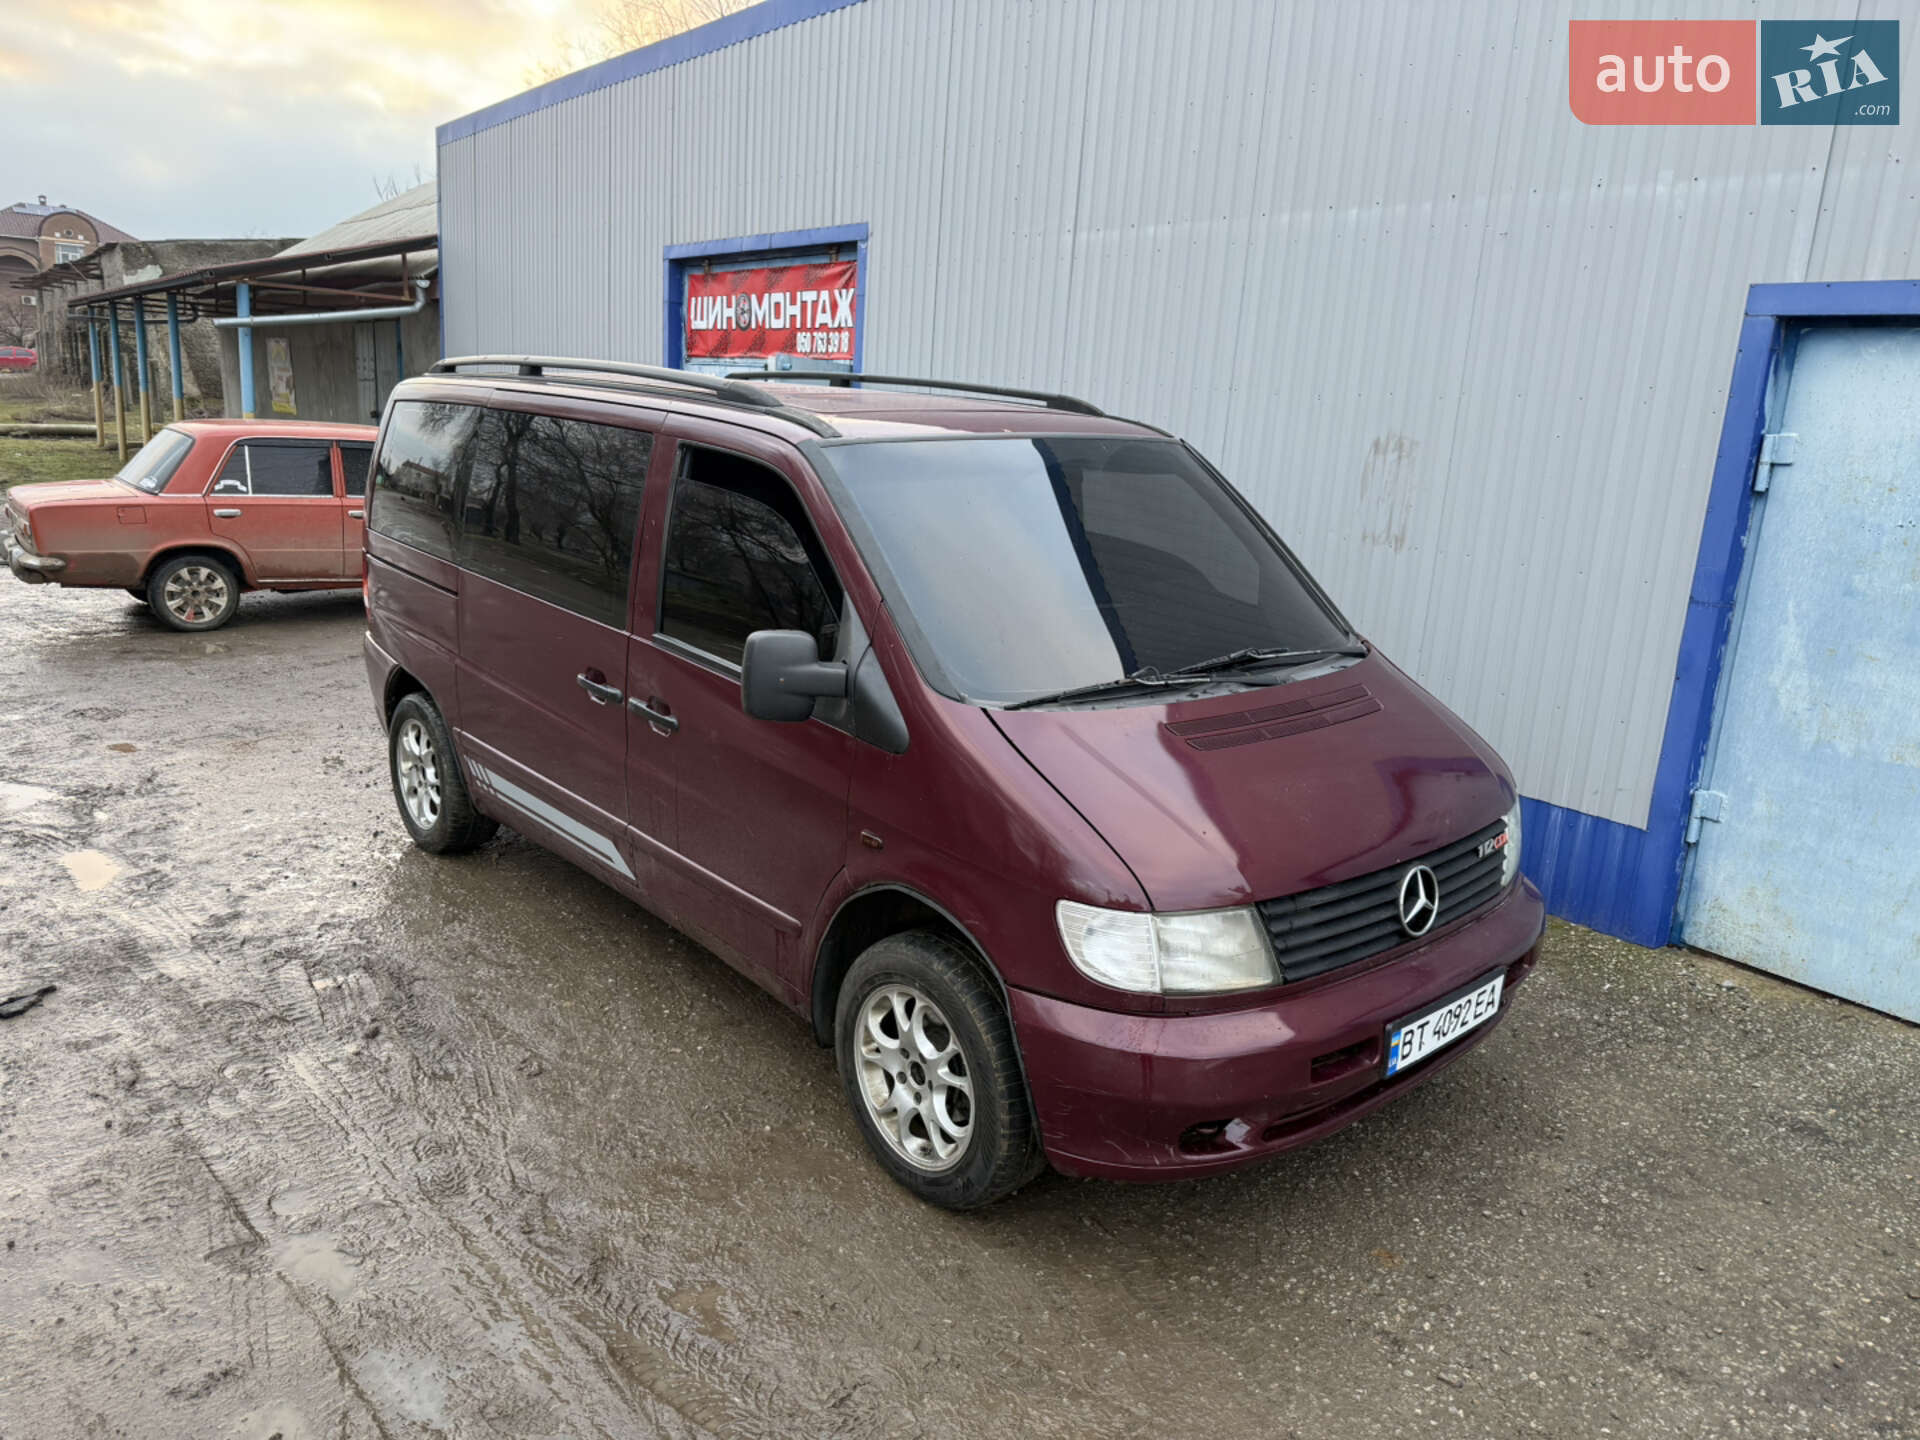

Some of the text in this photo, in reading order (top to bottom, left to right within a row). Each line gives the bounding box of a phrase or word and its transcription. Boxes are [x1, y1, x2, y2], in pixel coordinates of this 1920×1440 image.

[1401, 983, 1497, 1061] BT 4092 EA
